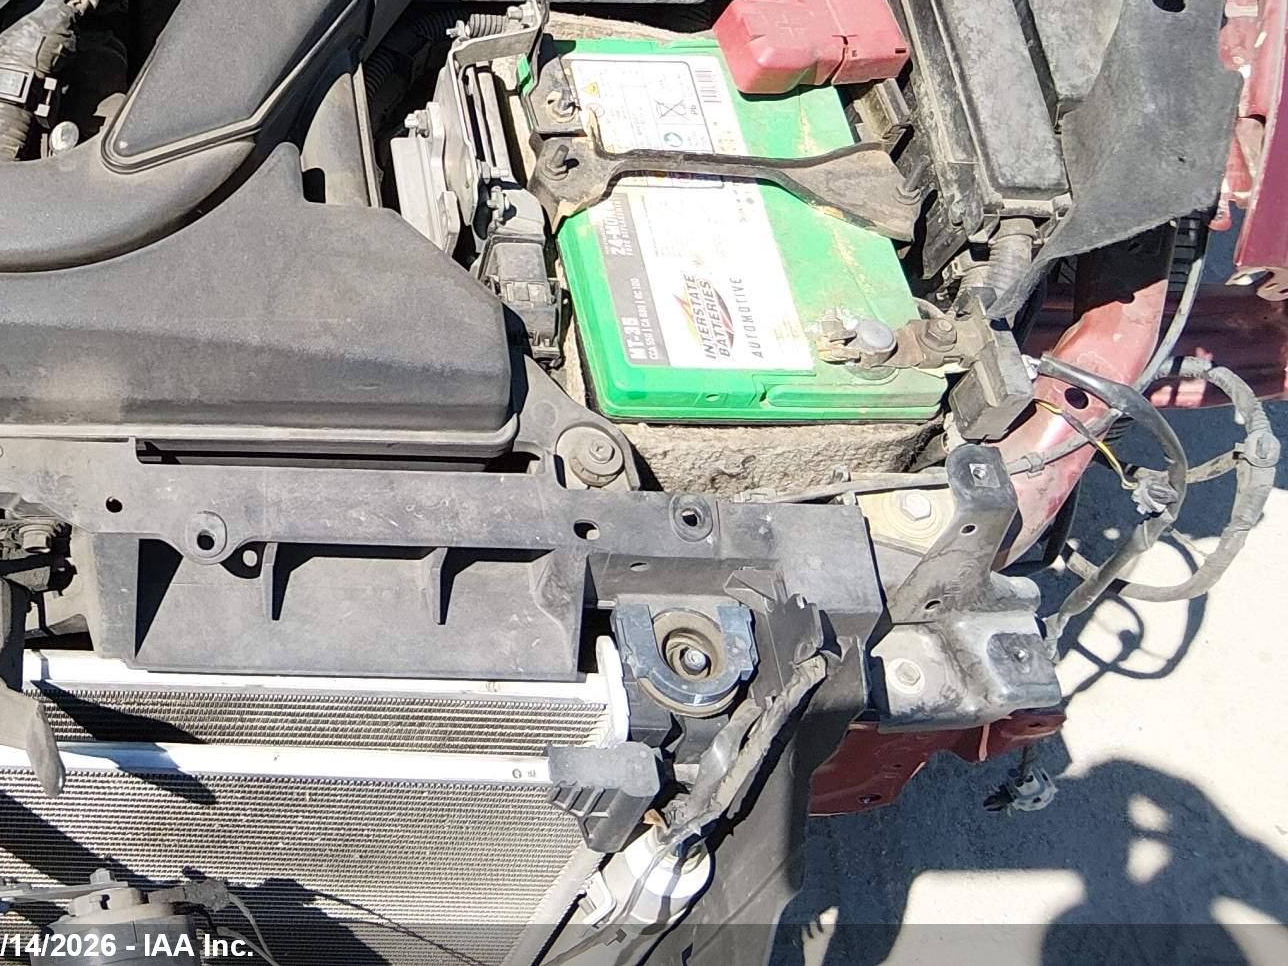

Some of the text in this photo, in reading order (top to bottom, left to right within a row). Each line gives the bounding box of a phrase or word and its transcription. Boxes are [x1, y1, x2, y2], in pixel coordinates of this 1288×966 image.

[621, 317, 648, 359] MT-35
[647, 346, 659, 360] CCA
[683, 274, 716, 359] INTERSTATE
[699, 280, 731, 357] BATTERIES
[729, 277, 764, 358] AUTOMOTIVE
